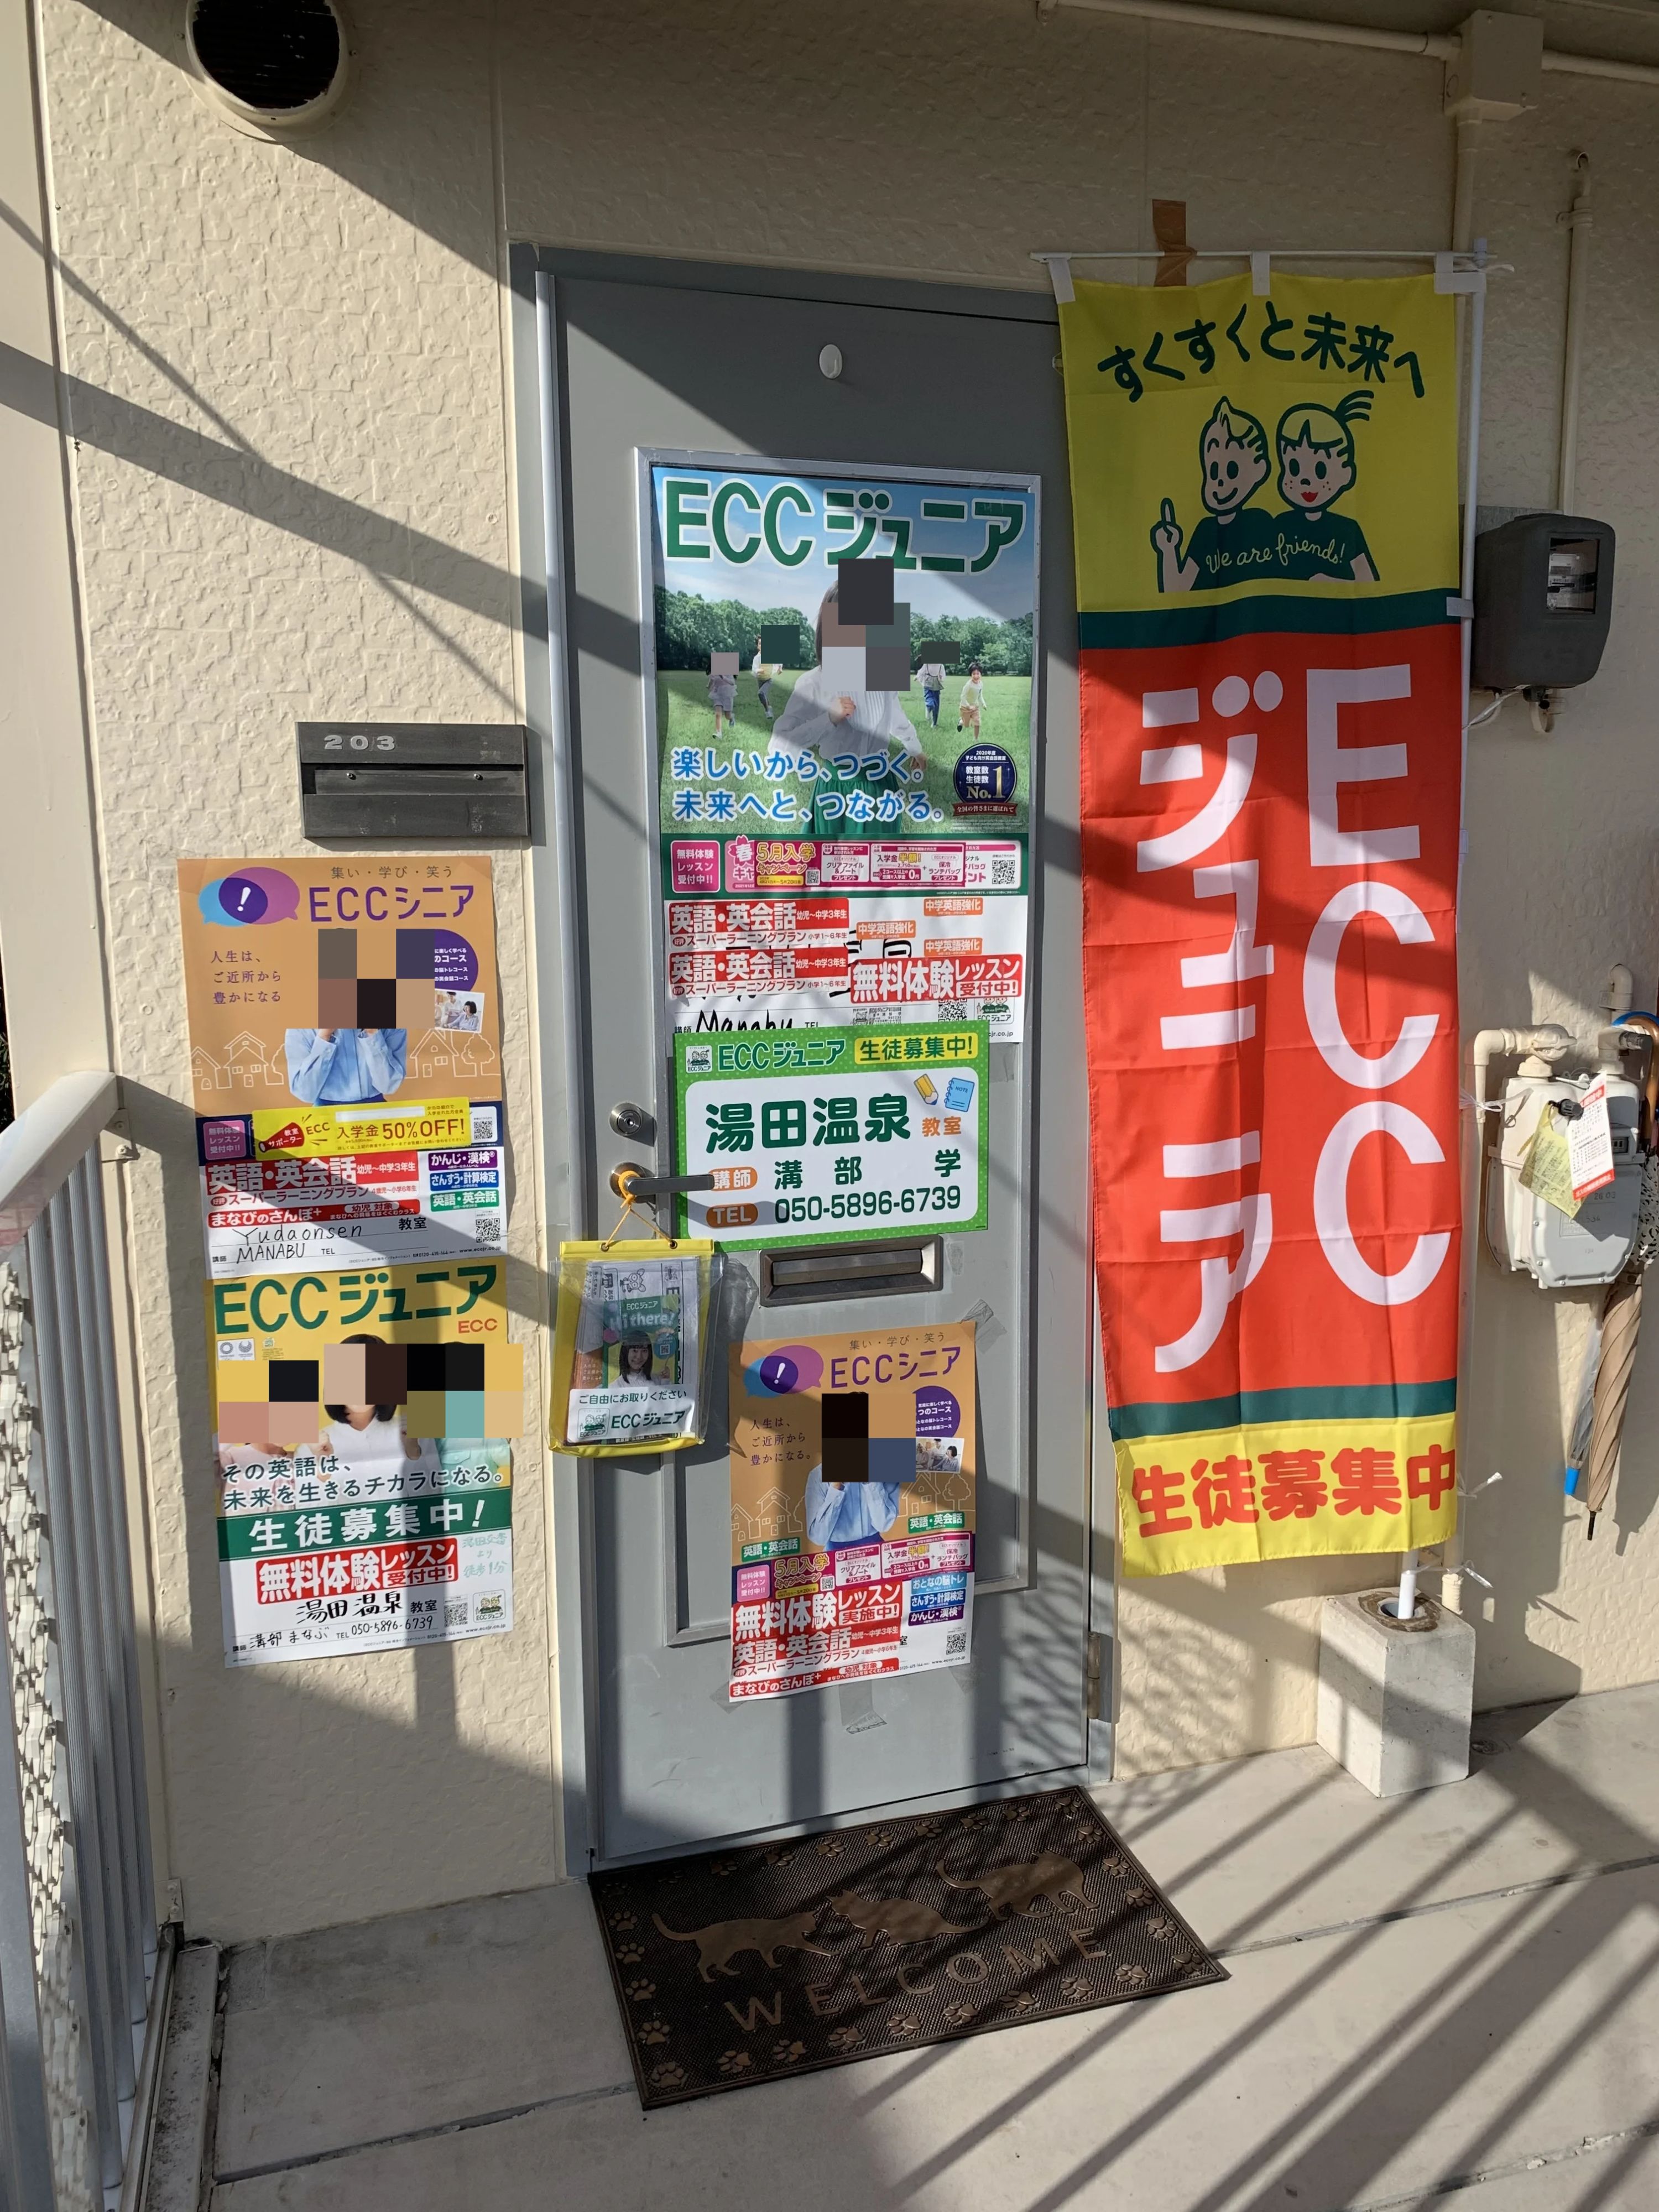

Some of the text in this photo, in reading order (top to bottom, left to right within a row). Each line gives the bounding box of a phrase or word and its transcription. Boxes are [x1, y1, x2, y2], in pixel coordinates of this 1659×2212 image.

[1097, 300, 1425, 403] すくすくと未来へ
[665, 480, 1024, 573] ECCジュニア
[1206, 534, 1345, 574] We are friends!
[324, 734, 395, 750] 203
[673, 749, 924, 783] 楽しいから、つづく。
[966, 766, 989, 774] 教室数
[966, 775, 989, 784] 生徒数
[673, 790, 943, 821] 未来へと、つながる。
[676, 849, 714, 859] 無料体験
[735, 844, 753, 862] 春
[758, 843, 815, 861] 5月入学
[331, 865, 452, 879] 集い・学び・笑う
[677, 862, 713, 872] レッスン
[758, 864, 807, 874] キャンペーン
[909, 869, 920, 879] 0円
[309, 885, 474, 922] ECCシニア
[925, 899, 980, 911] 中学英語強化
[672, 902, 796, 934] 英語・英会話
[858, 922, 914, 935] 中学英語強化
[687, 932, 806, 946] スーパーラーニングプラン
[925, 940, 980, 952] 中学英語強化
[211, 951, 261, 963] 人生は、
[671, 951, 795, 984] 英語・英会話
[214, 970, 280, 983] ご近所から
[1303, 664, 1451, 1306] ECC
[686, 980, 805, 995] スーパーラーニングプラン
[960, 982, 1017, 995] 受付中!
[213, 990, 280, 1004] 豊かになる
[1136, 670, 1282, 1373] ジュニア
[718, 1039, 846, 1071] ECCジュニア
[859, 1036, 973, 1061] 生徒募集中!
[209, 1126, 240, 1135] 無料体験
[306, 1123, 330, 1134] ECC
[706, 1093, 962, 1154] 湯田温泉 教室
[269, 1136, 301, 1146] サポーター
[208, 1156, 357, 1194] 英語・英会話
[431, 1172, 497, 1186] さんすう・計算検定
[712, 1169, 751, 1189] 講師
[228, 1187, 369, 1205] スーパーラーニングプラン
[433, 1191, 497, 1206] 英語・英会話
[712, 1186, 961, 1223] TEL 050-5896-6739
[398, 1217, 427, 1230] 教室
[232, 1224, 362, 1246] Yudaonsen
[237, 1243, 305, 1264] MANABU
[214, 1265, 497, 1334] ECCジュニア
[627, 1301, 658, 1311] ECCジュニア
[458, 1318, 498, 1333] ECC
[630, 1311, 675, 1327] there!
[849, 1332, 945, 1350] 集い・学び・笑う
[831, 1347, 961, 1388] ECCシニア
[580, 1390, 686, 1404] ご自由にお取りください
[611, 1411, 685, 1428] ECCジュニア
[750, 1417, 790, 1431] 人生は、
[752, 1432, 806, 1447] ご近所から
[750, 1450, 811, 1467] 豊かになる。
[223, 1455, 353, 1484] その英語は、
[224, 1464, 502, 1511] 未来を生きるチカラになる。
[1134, 1444, 1455, 1538] 生徒募集中
[249, 1499, 486, 1552] 生徒募集中!
[910, 1512, 962, 1529] 英語・英会話
[477, 1550, 492, 1558] より
[743, 1538, 797, 1558] 英語・英会話
[775, 1553, 830, 1577] 5月入学
[918, 1561, 928, 1569] 0円
[937, 1553, 968, 1562] ランチバッグ
[388, 1566, 454, 1586] 受付中!
[741, 1571, 766, 1580] 無料体験
[841, 1563, 876, 1573] クリアファイル
[741, 1579, 765, 1588] レッスン
[775, 1572, 822, 1589] キャンペーン
[913, 1574, 964, 1589] おとなの脳トレ
[410, 1599, 437, 1614] 教室
[912, 1590, 964, 1606] さんすう・計算検定
[296, 1590, 403, 1625] 湯田温泉
[842, 1605, 898, 1624] 実施中!
[352, 1615, 432, 1635] 050-5896-6739
[476, 1612, 504, 1621] ECCジュニア
[289, 1626, 329, 1644] まなぶ
[734, 1627, 852, 1667] 英語・英会話
[748, 1650, 859, 1676] スーパーラーニングプラン
[724, 1927, 1109, 2032] WELCOME
